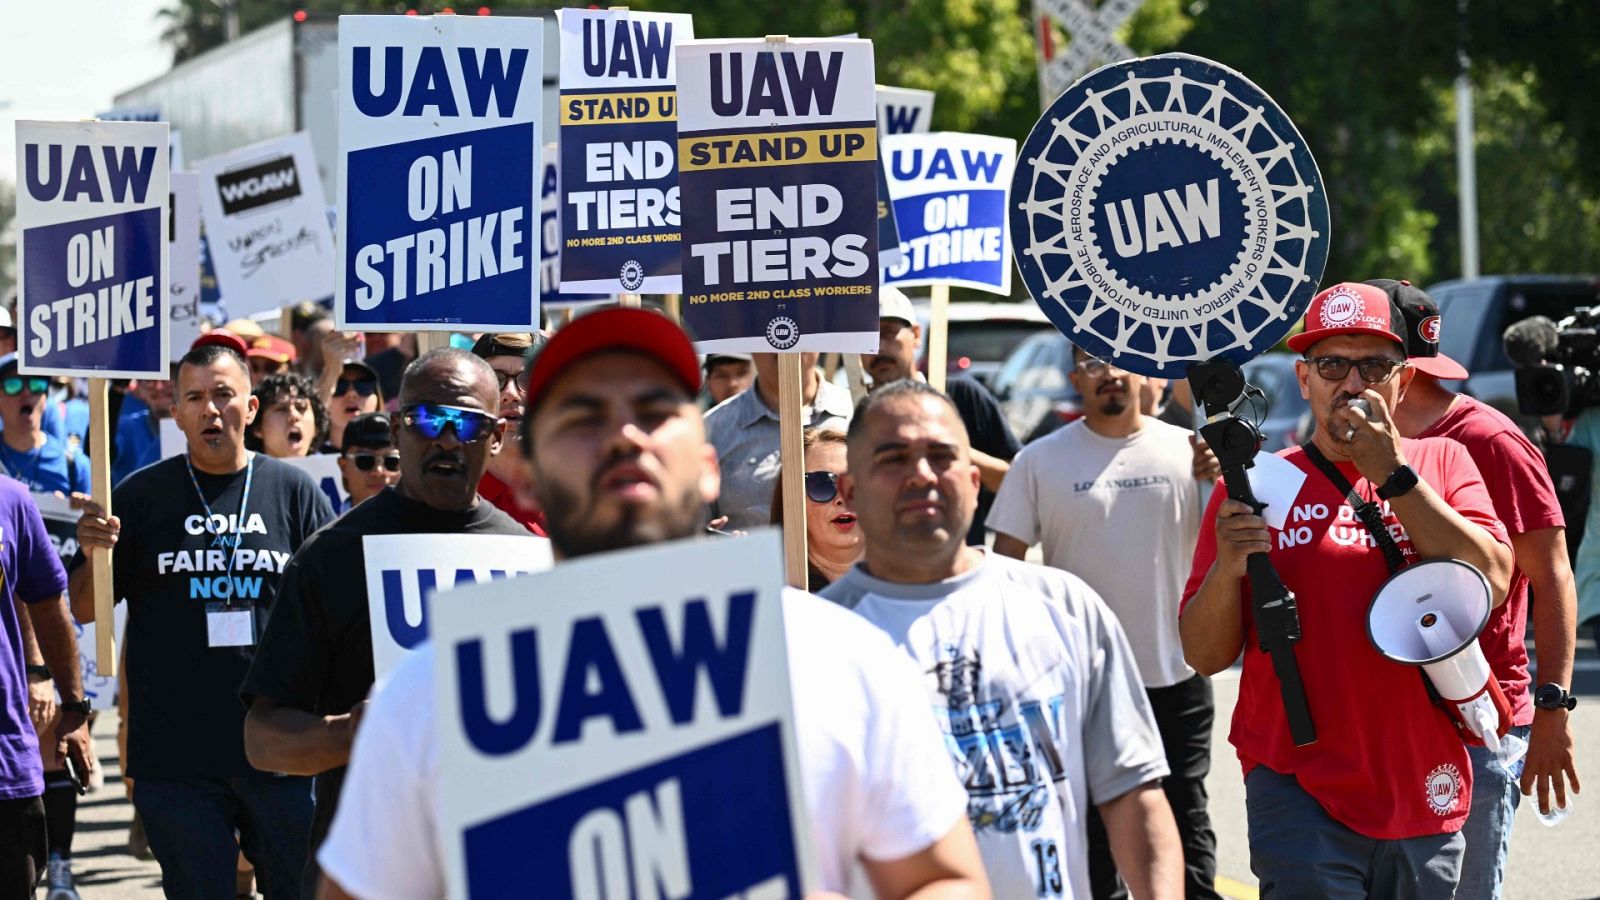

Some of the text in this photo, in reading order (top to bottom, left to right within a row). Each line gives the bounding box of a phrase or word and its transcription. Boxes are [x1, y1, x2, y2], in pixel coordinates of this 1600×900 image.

[583, 18, 673, 79] UAW
[352, 46, 529, 118] UAW
[709, 51, 843, 117] UAW
[569, 96, 650, 121] STAND
[586, 140, 674, 182] END
[689, 133, 865, 165] STAND UP
[892, 148, 1003, 183] UAW
[25, 143, 157, 203] UAW
[408, 145, 472, 222] ON
[568, 186, 681, 231] TIERS
[716, 183, 843, 232] END
[923, 193, 969, 232] ON
[1071, 121, 1268, 320] UNITED AUTOMOBILE, AEROSPACE AND AGRICULTURAL IMPLEMENT WORKERS OF AMERICA
[1104, 178, 1221, 258] UAW
[67, 225, 114, 288] ON
[355, 206, 523, 311] STRIKE
[567, 239, 580, 248] NO
[582, 237, 605, 247] MORE
[607, 236, 624, 245] 2ND
[626, 235, 652, 244] CLASS
[691, 233, 870, 285] TIERS
[889, 227, 1001, 277] STRIKE
[690, 285, 872, 304] NO MORE 2ND CLASS WORKERS
[1331, 303, 1351, 315] UAW
[30, 275, 154, 358] STRIKE
[775, 328, 789, 336] UAW
[1362, 315, 1387, 325] LOCAL
[184, 513, 267, 535] COLA
[1293, 504, 1329, 522] NO
[211, 536, 243, 547] AND
[1278, 526, 1312, 550] NO
[158, 549, 290, 574] FAIR PAY
[190, 576, 263, 599] NOW
[454, 589, 759, 758] UAW
[1433, 783, 1451, 797] UAW
[568, 777, 692, 900] ON
[1031, 838, 1063, 899] 13
